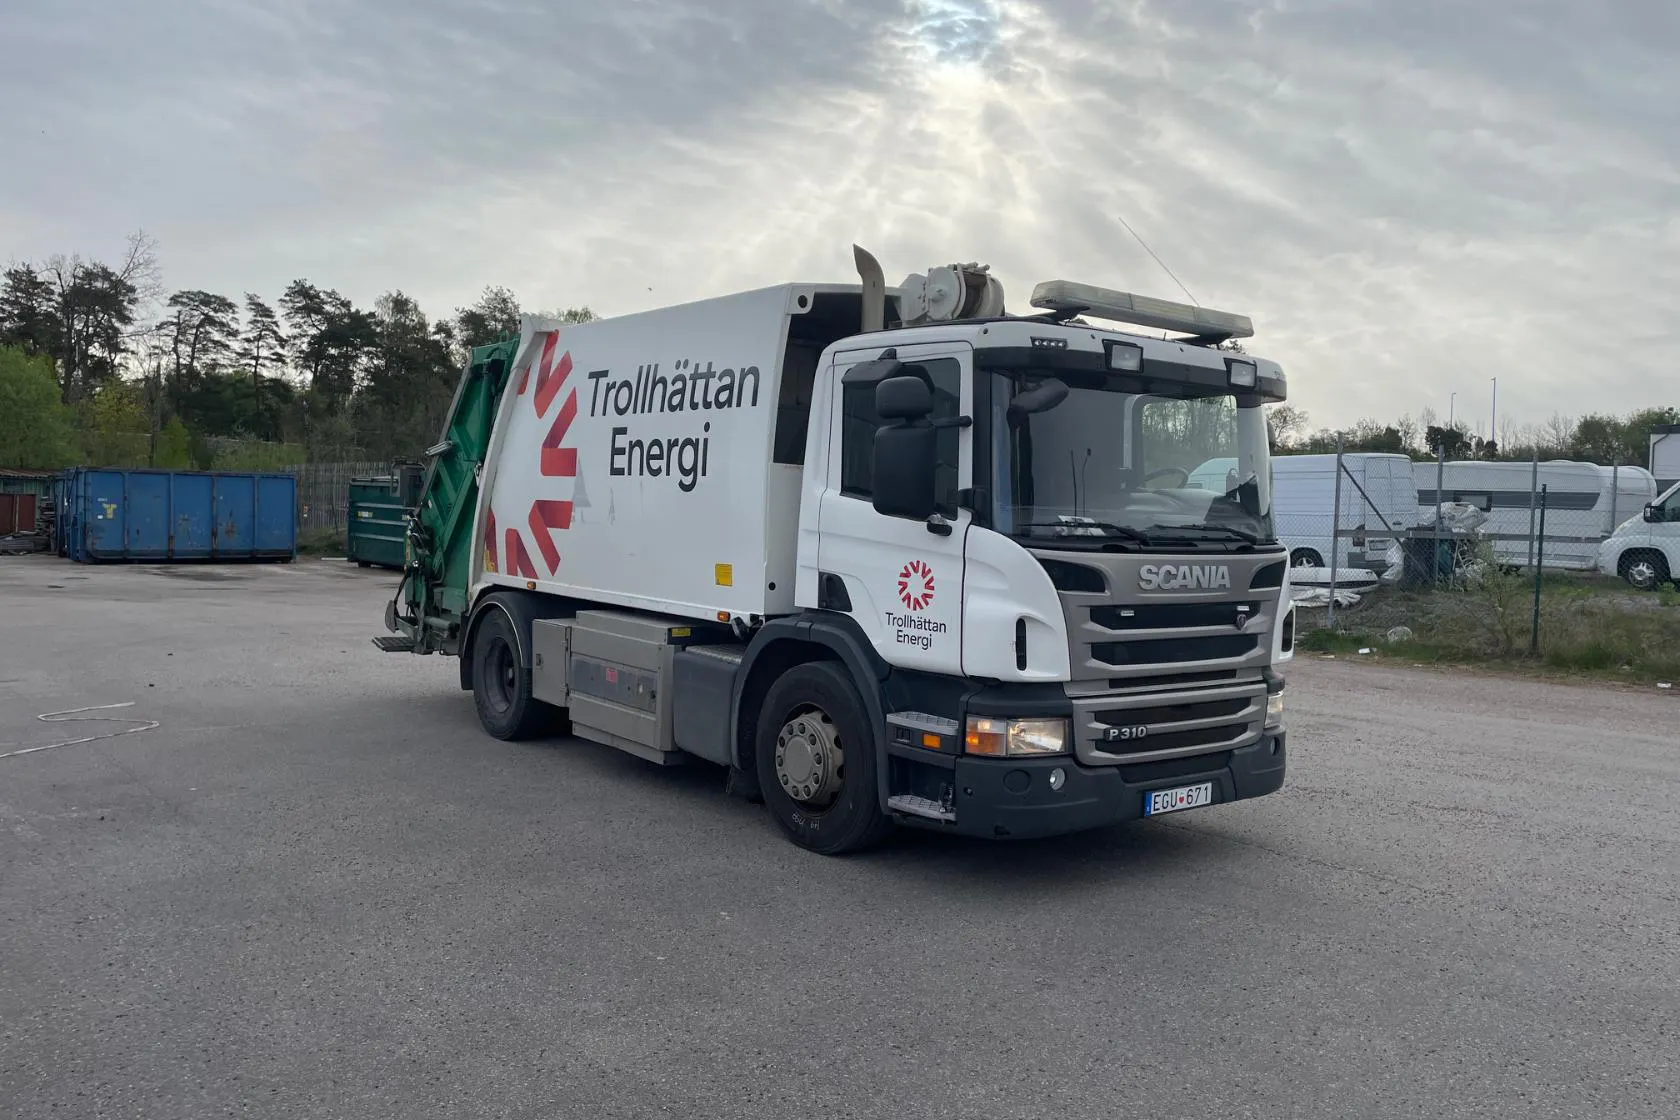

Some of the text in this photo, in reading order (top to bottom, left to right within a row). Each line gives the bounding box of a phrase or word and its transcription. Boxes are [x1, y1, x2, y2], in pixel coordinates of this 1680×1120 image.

[588, 359, 760, 417] Trollhättan
[609, 421, 711, 492] Energi
[1138, 565, 1231, 590] SCANIA
[885, 612, 947, 634] Trollhättan
[896, 629, 932, 650] Energi
[1109, 726, 1147, 740] P 310
[1153, 785, 1209, 811] EGU 671
